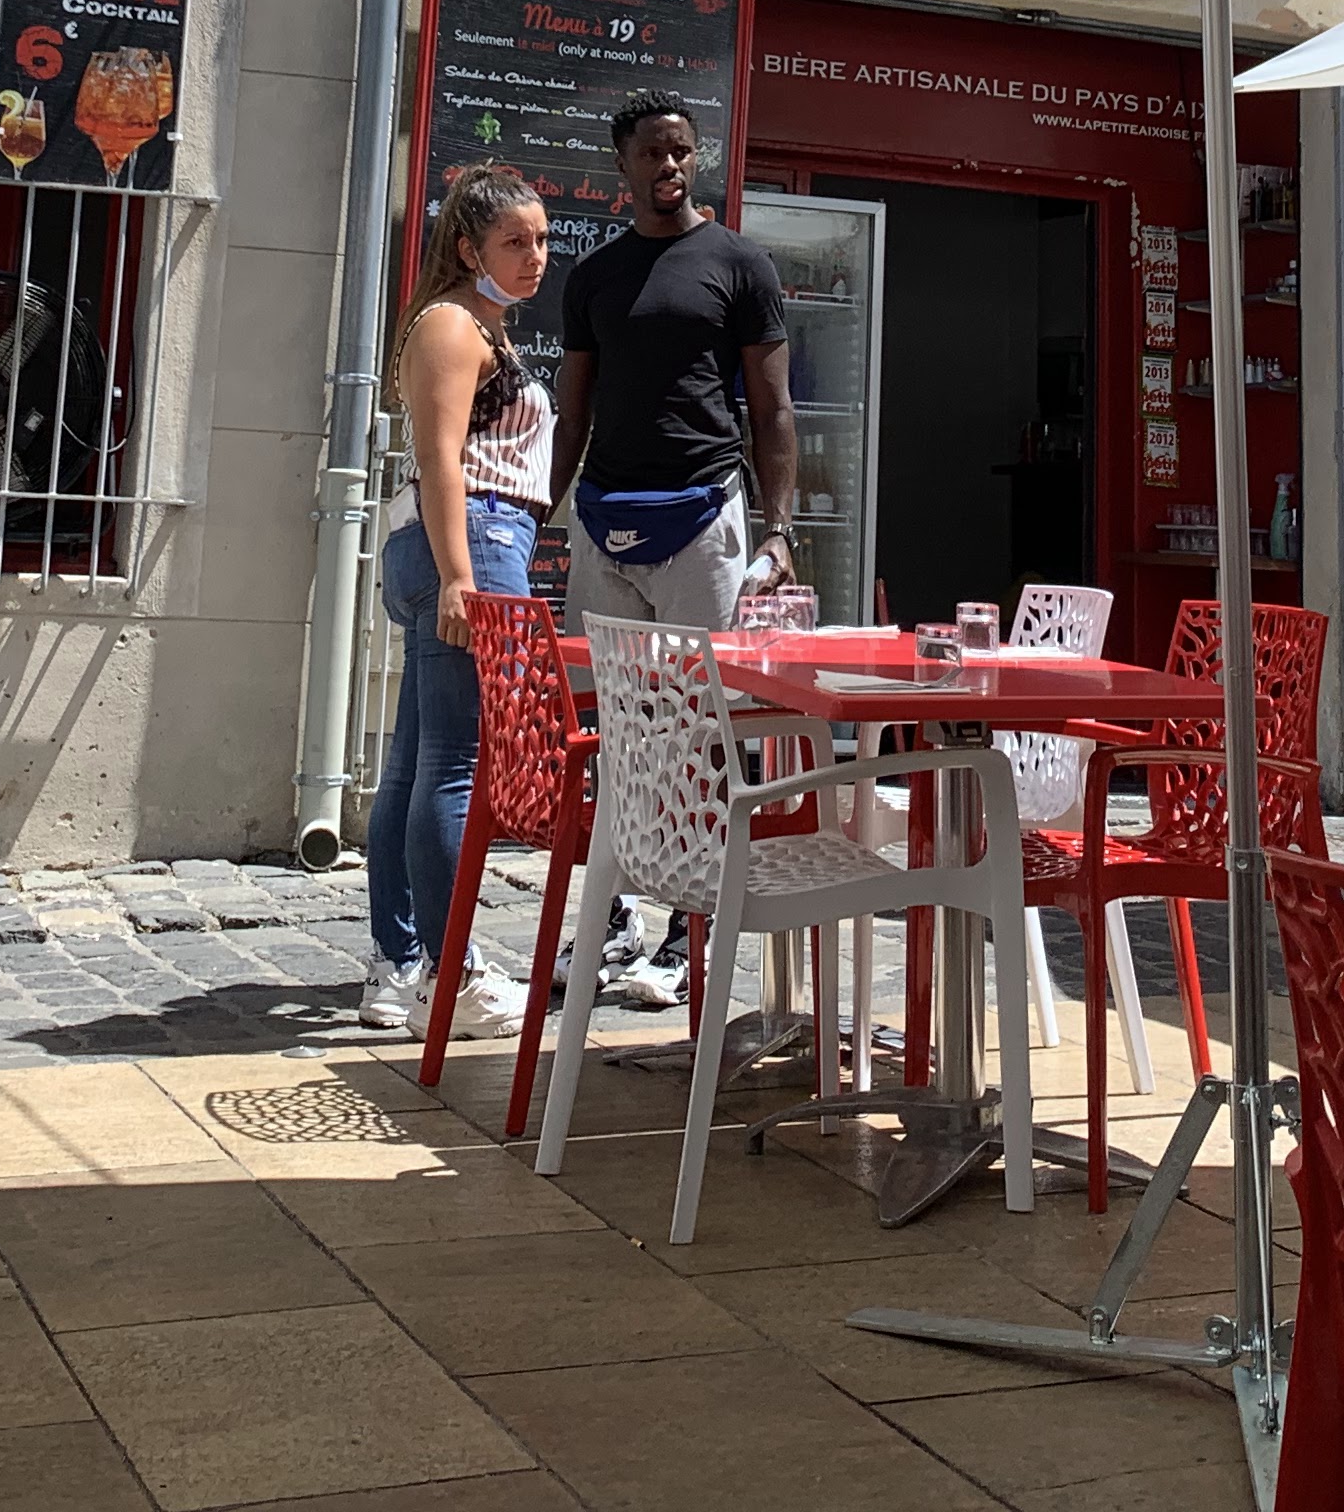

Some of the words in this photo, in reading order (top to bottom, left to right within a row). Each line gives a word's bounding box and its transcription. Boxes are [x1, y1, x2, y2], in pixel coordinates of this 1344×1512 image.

[523, 2, 590, 36] Menu
[592, 17, 605, 37] à
[608, 18, 635, 42] 19
[454, 29, 514, 48] Seulement
[558, 41, 587, 58] (only
[590, 48, 601, 58] at
[604, 50, 636, 65] noon)
[640, 53, 654, 64] de
[444, 65, 486, 80] Salade
[488, 71, 502, 82] de
[763, 51, 846, 80] BIÈRE
[854, 65, 1024, 100] ARTISANALE
[1032, 83, 1067, 104] DU
[1075, 89, 1139, 113] PAYS
[1147, 237, 1172, 251] 2015
[1148, 301, 1173, 314] 2014
[1145, 366, 1169, 379] 2013
[1149, 431, 1174, 446] 2012
[608, 529, 638, 541] NIKE
